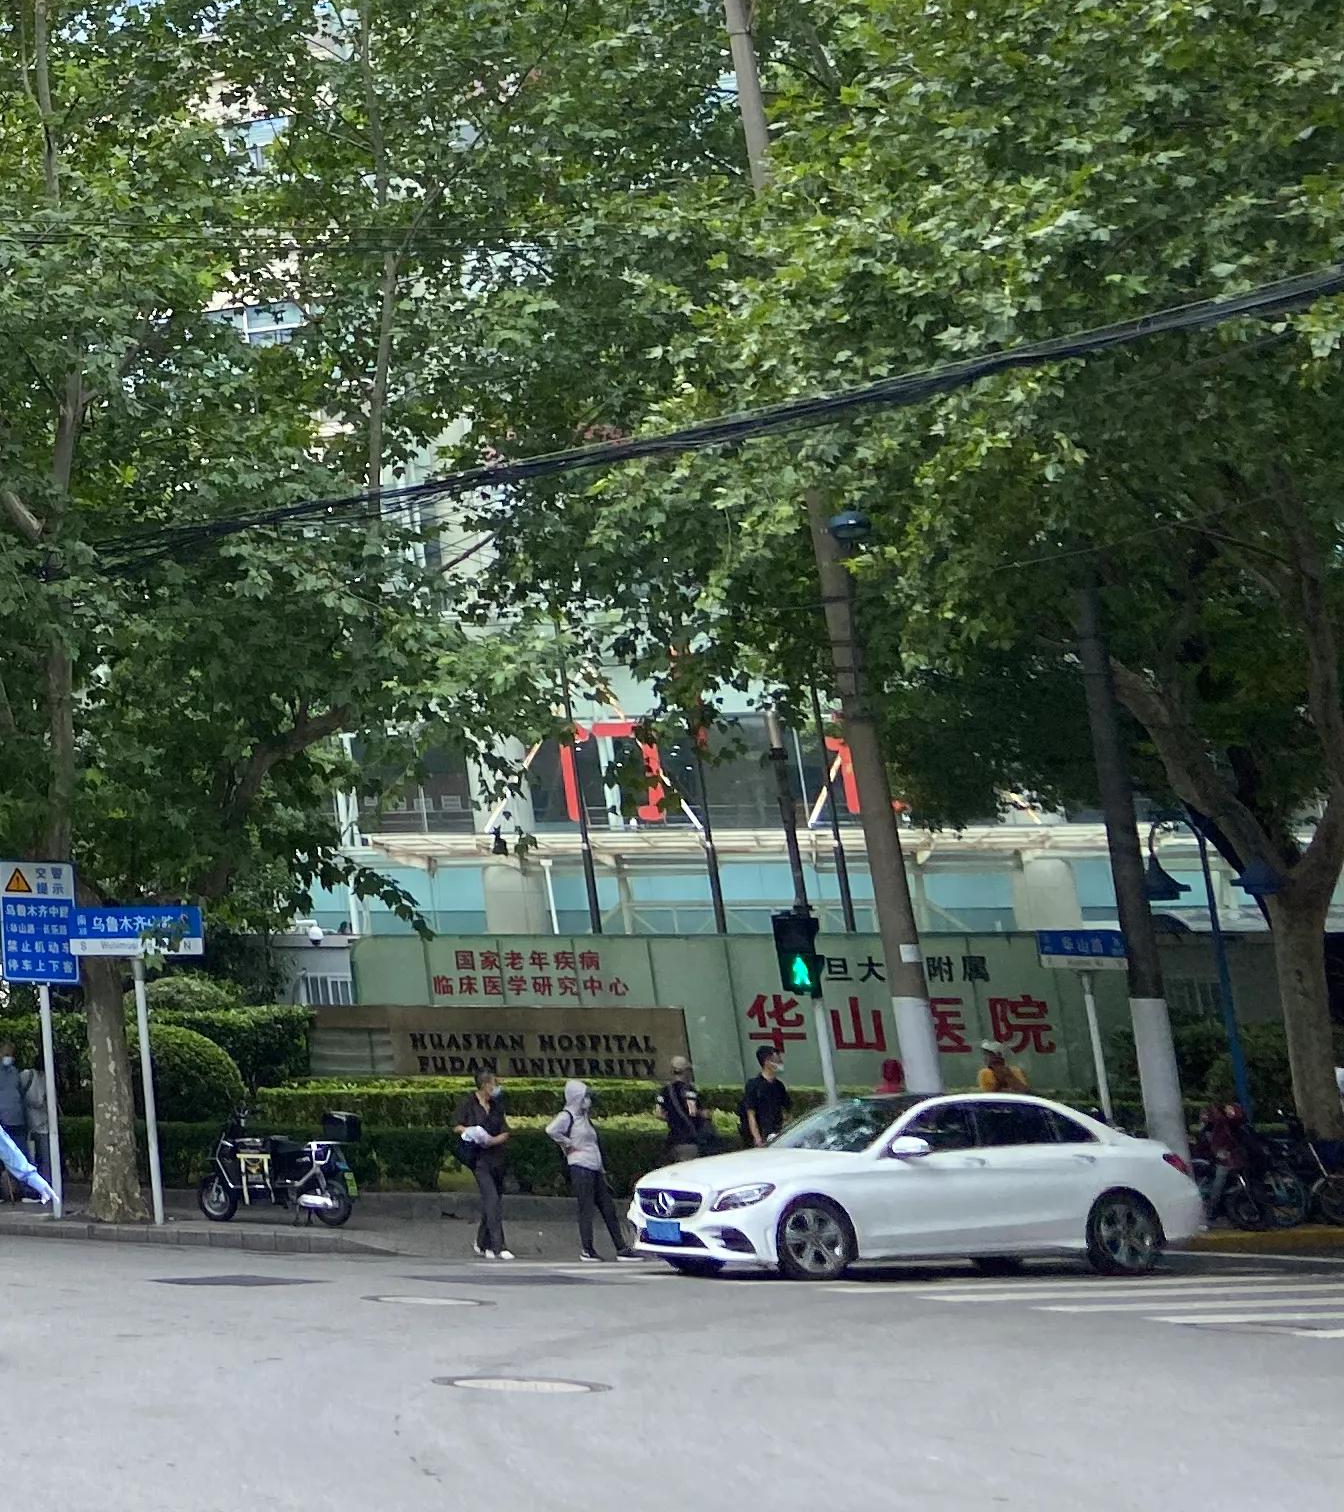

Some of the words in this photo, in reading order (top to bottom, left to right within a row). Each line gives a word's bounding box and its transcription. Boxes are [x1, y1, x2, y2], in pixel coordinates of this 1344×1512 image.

[37, 882, 64, 895] 提示
[5, 904, 69, 918] 乌鲁木齐中路
[454, 950, 600, 971] 国家老年疾病
[825, 955, 991, 983] 旦大附属
[432, 975, 630, 997] 临床医学研究中心
[746, 993, 1057, 1053] 华山医院
[409, 1032, 525, 1052] HUASHAN
[536, 1034, 657, 1054] HOSPITAL
[416, 1055, 498, 1073] FUDAN
[510, 1056, 656, 1078] UNIVERSITY
